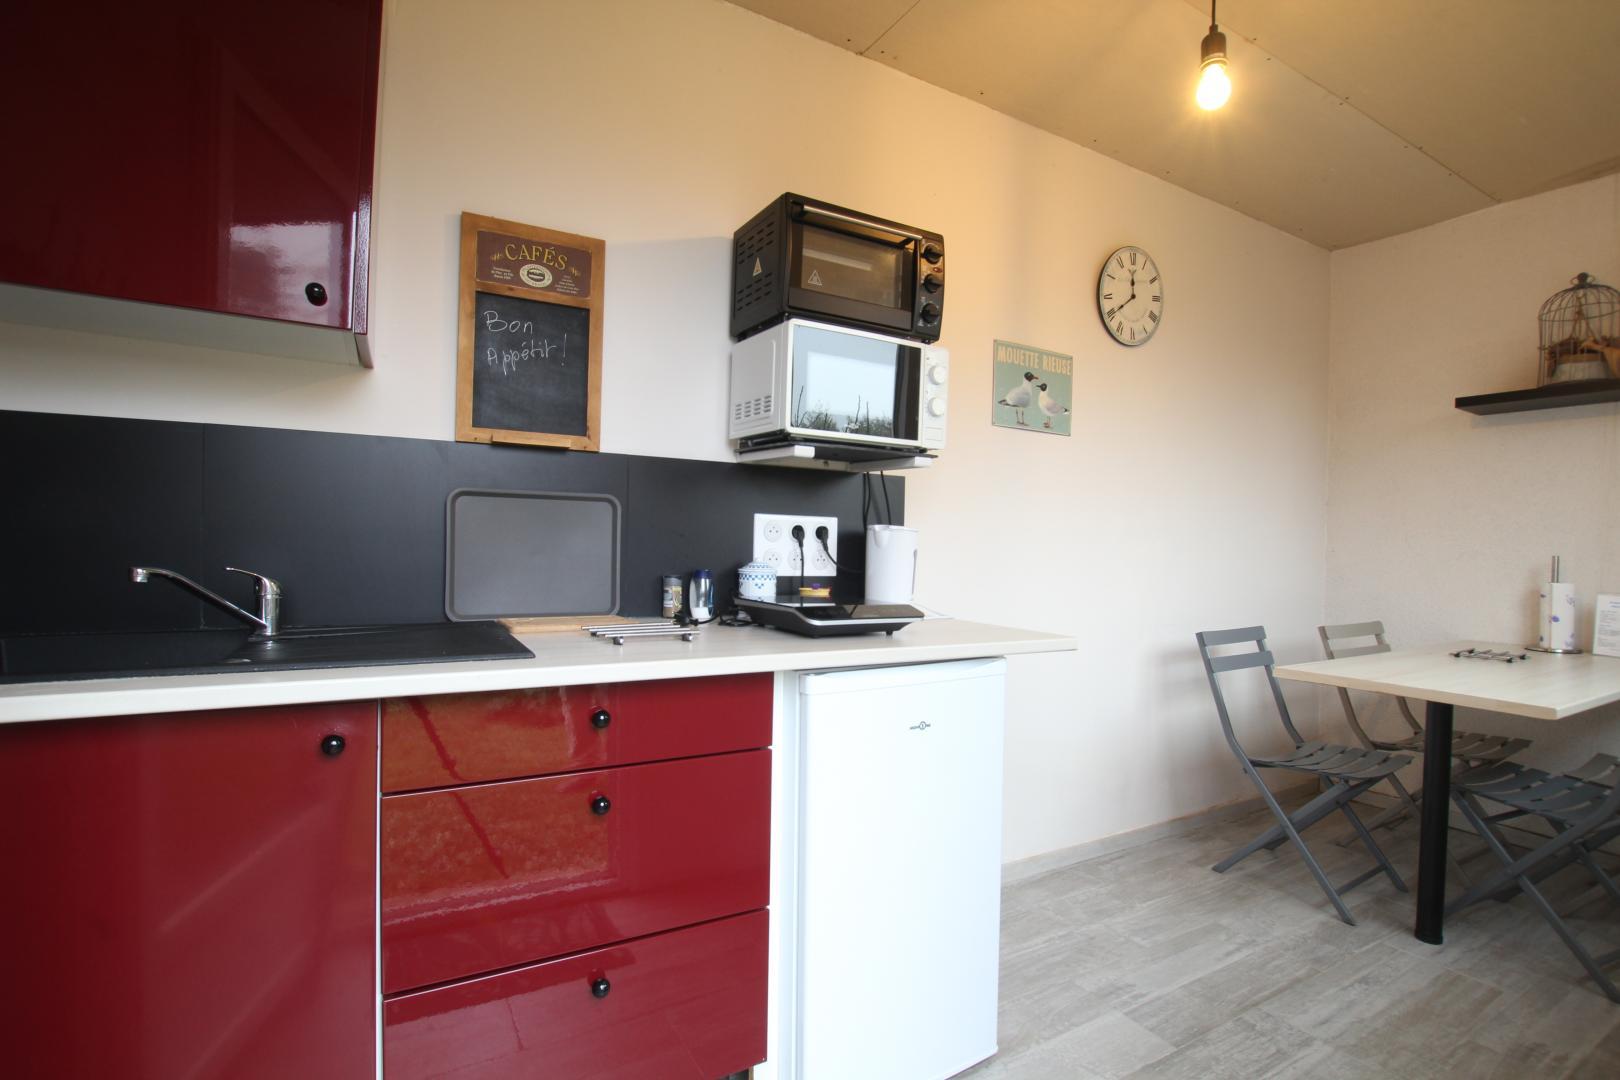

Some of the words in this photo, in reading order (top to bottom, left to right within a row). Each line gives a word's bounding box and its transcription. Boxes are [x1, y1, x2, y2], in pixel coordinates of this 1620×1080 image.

[505, 244, 568, 271] CAFÉS
[483, 310, 533, 334] Bon
[997, 345, 1040, 369] MOUETTE
